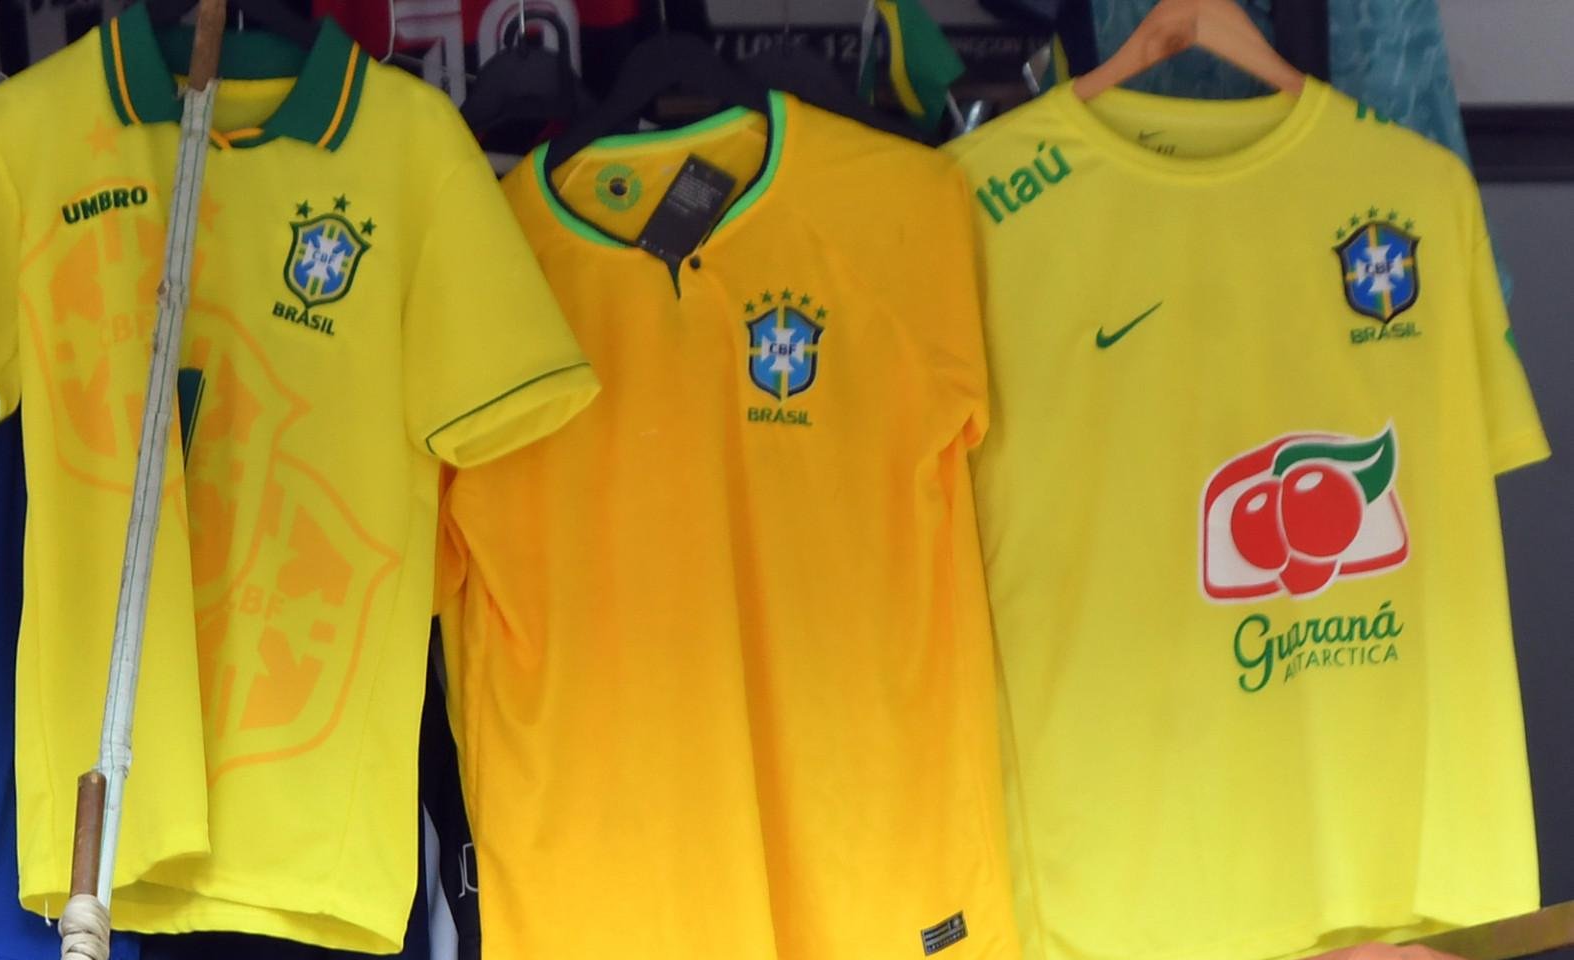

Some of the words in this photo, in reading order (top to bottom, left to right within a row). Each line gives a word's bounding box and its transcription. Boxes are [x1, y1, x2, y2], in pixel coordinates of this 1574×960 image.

[977, 138, 1072, 224] Itaú
[61, 185, 149, 225] UMBRO
[271, 301, 335, 337] BRASIL
[1350, 319, 1421, 345] BRASIL
[768, 342, 797, 356] CBF
[747, 405, 813, 427] BRASIL
